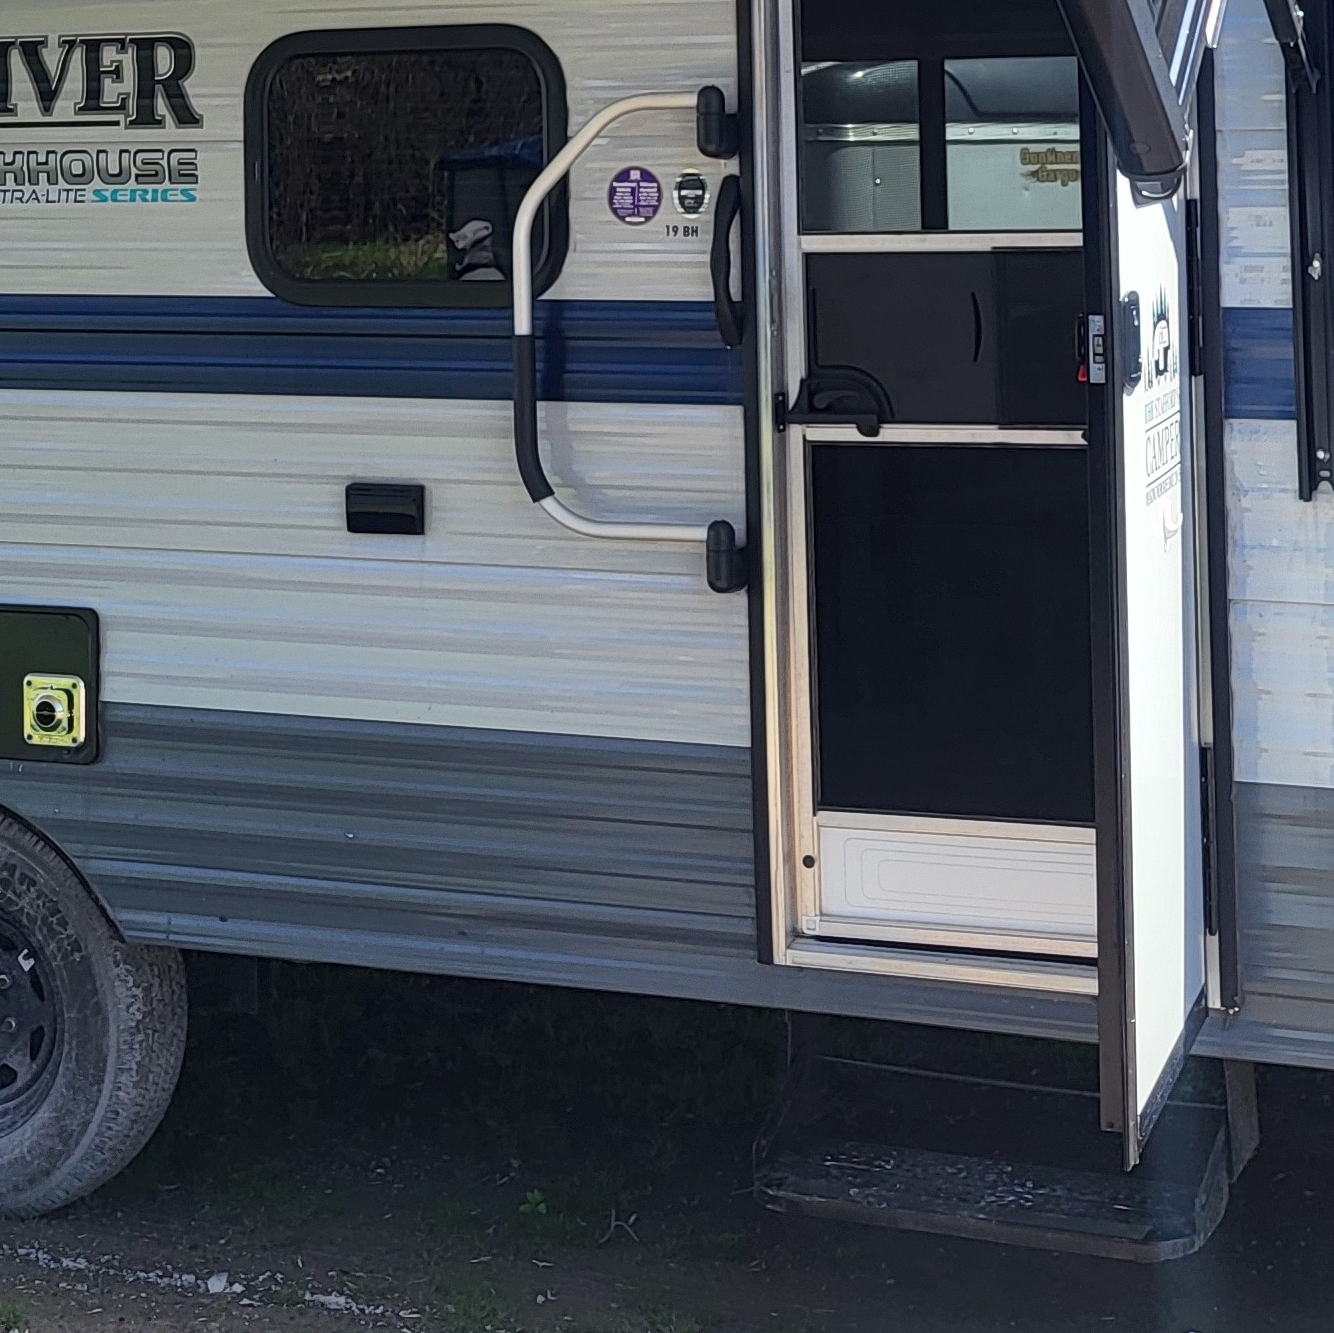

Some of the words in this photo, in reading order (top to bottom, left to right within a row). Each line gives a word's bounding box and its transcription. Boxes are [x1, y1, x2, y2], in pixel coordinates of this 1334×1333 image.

[91, 188, 198, 204] SERIES
[666, 225, 679, 237] 19
[683, 225, 698, 238] BH
